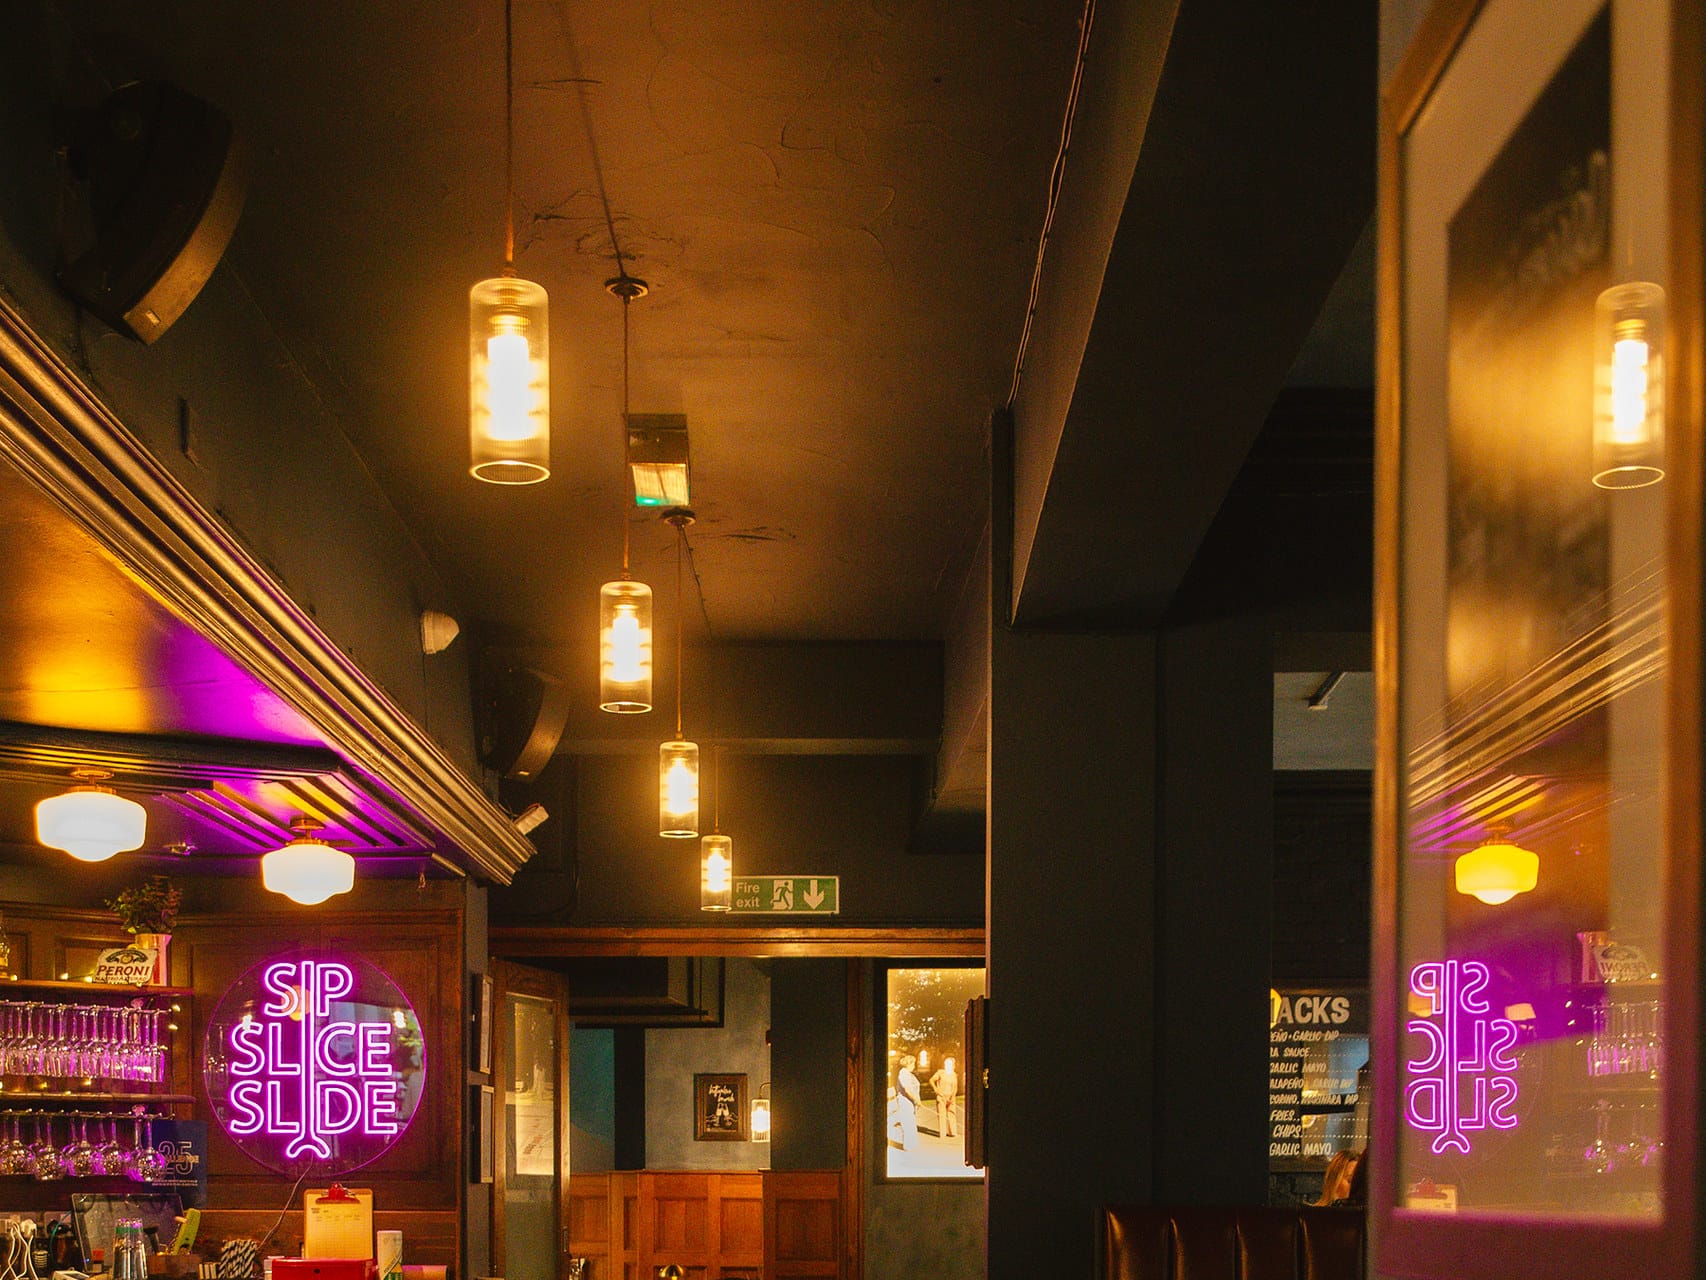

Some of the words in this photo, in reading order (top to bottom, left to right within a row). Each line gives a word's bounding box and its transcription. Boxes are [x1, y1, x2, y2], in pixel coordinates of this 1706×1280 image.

[736, 882, 761, 893] Fire
[736, 896, 761, 908] exit
[96, 965, 150, 976] PERONI
[264, 961, 354, 1017] SIP
[1271, 996, 1351, 1024] ACKS
[1293, 1030, 1323, 1041] GARLIC
[1325, 1030, 1340, 1041] DIP
[231, 1021, 393, 1077] SLICE
[1284, 1047, 1311, 1057] SAUCE
[1302, 1062, 1327, 1073] MAYO
[230, 1079, 398, 1135] SLIDE
[1273, 1124, 1302, 1138] CHIPS
[1270, 1142, 1301, 1156] GARLIC
[1303, 1142, 1332, 1156] MAYO
